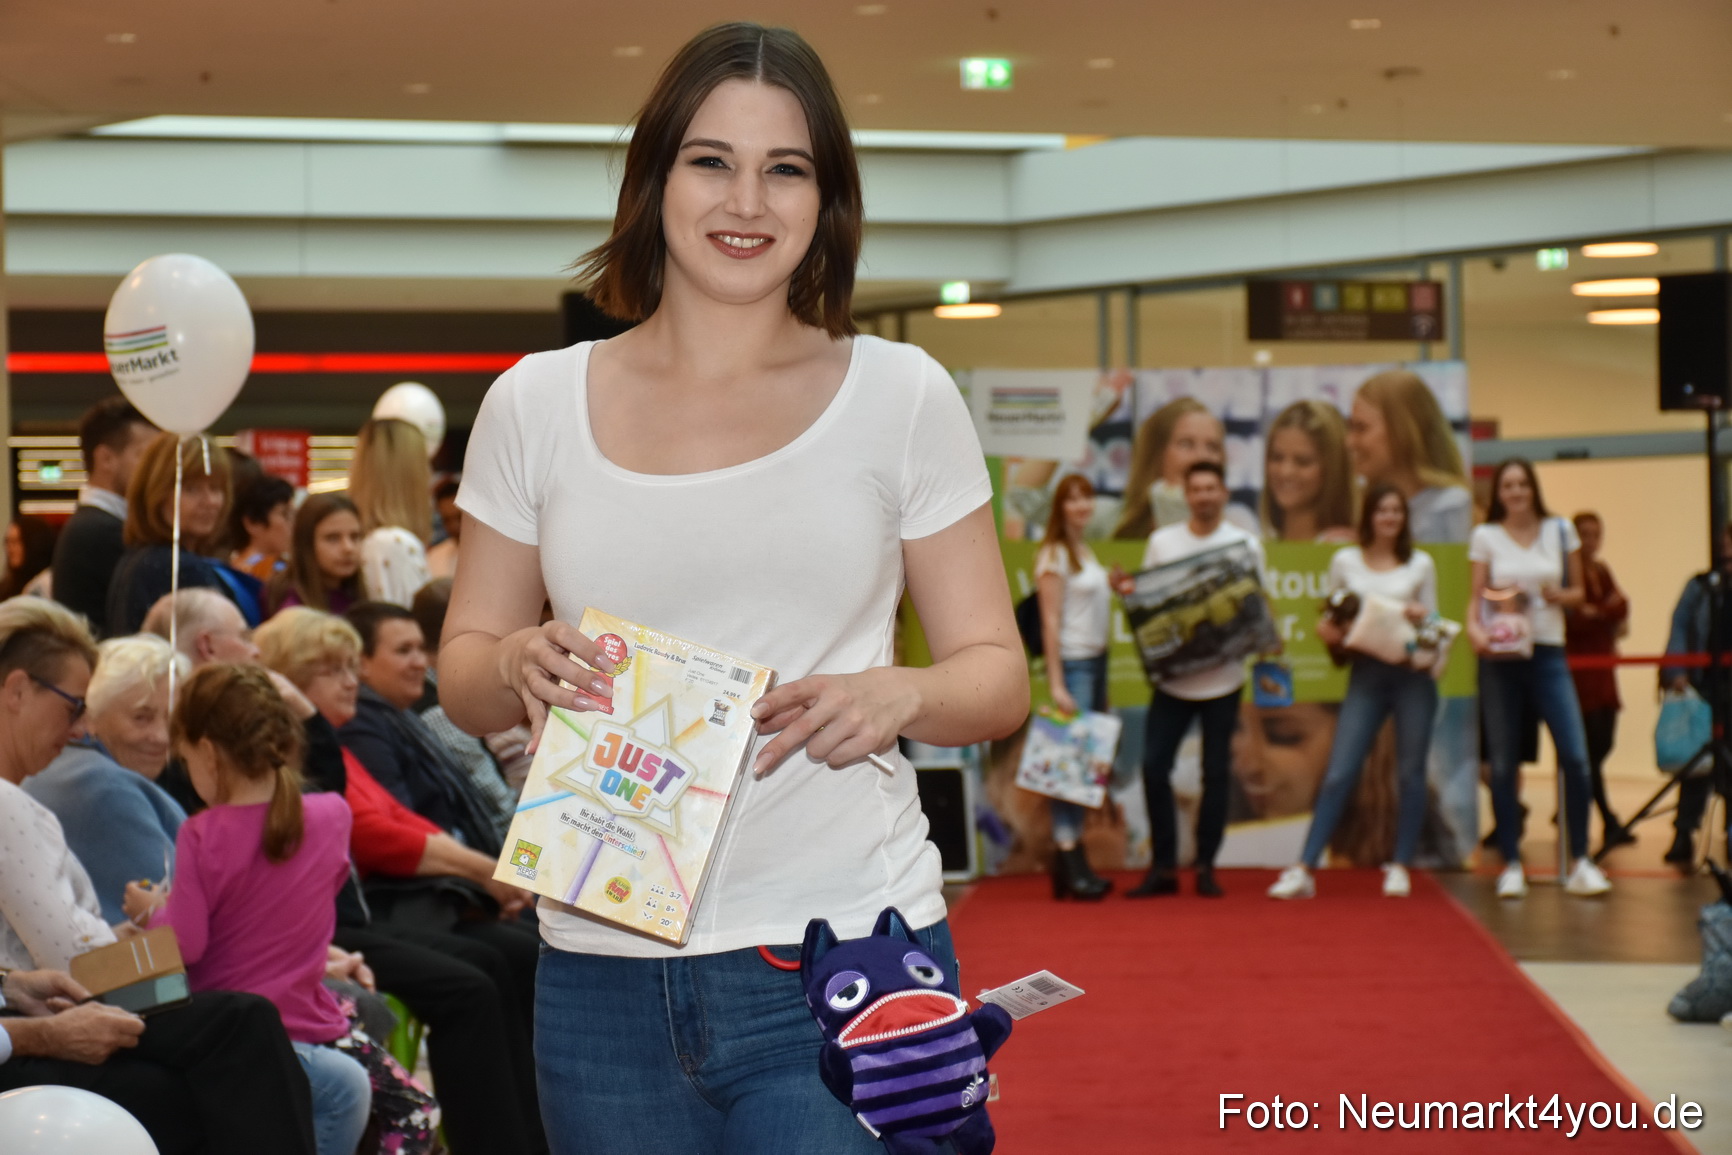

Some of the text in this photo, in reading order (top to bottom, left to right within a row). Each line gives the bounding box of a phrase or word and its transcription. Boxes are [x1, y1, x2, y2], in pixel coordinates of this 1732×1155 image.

[603, 636, 622, 648] Spiel
[634, 641, 654, 654] Ludovic
[605, 645, 618, 654] des
[692, 655, 723, 669] Spielwaren
[593, 732, 686, 794] JUST
[599, 769, 652, 811] ONE
[579, 808, 589, 818] Ihr
[590, 813, 605, 825] habt
[605, 821, 616, 831] die
[560, 812, 645, 858] Ihr macht den Unterschied!
[517, 865, 538, 878] REPOS
[669, 891, 682, 900] 3-7
[665, 905, 675, 913] 8+
